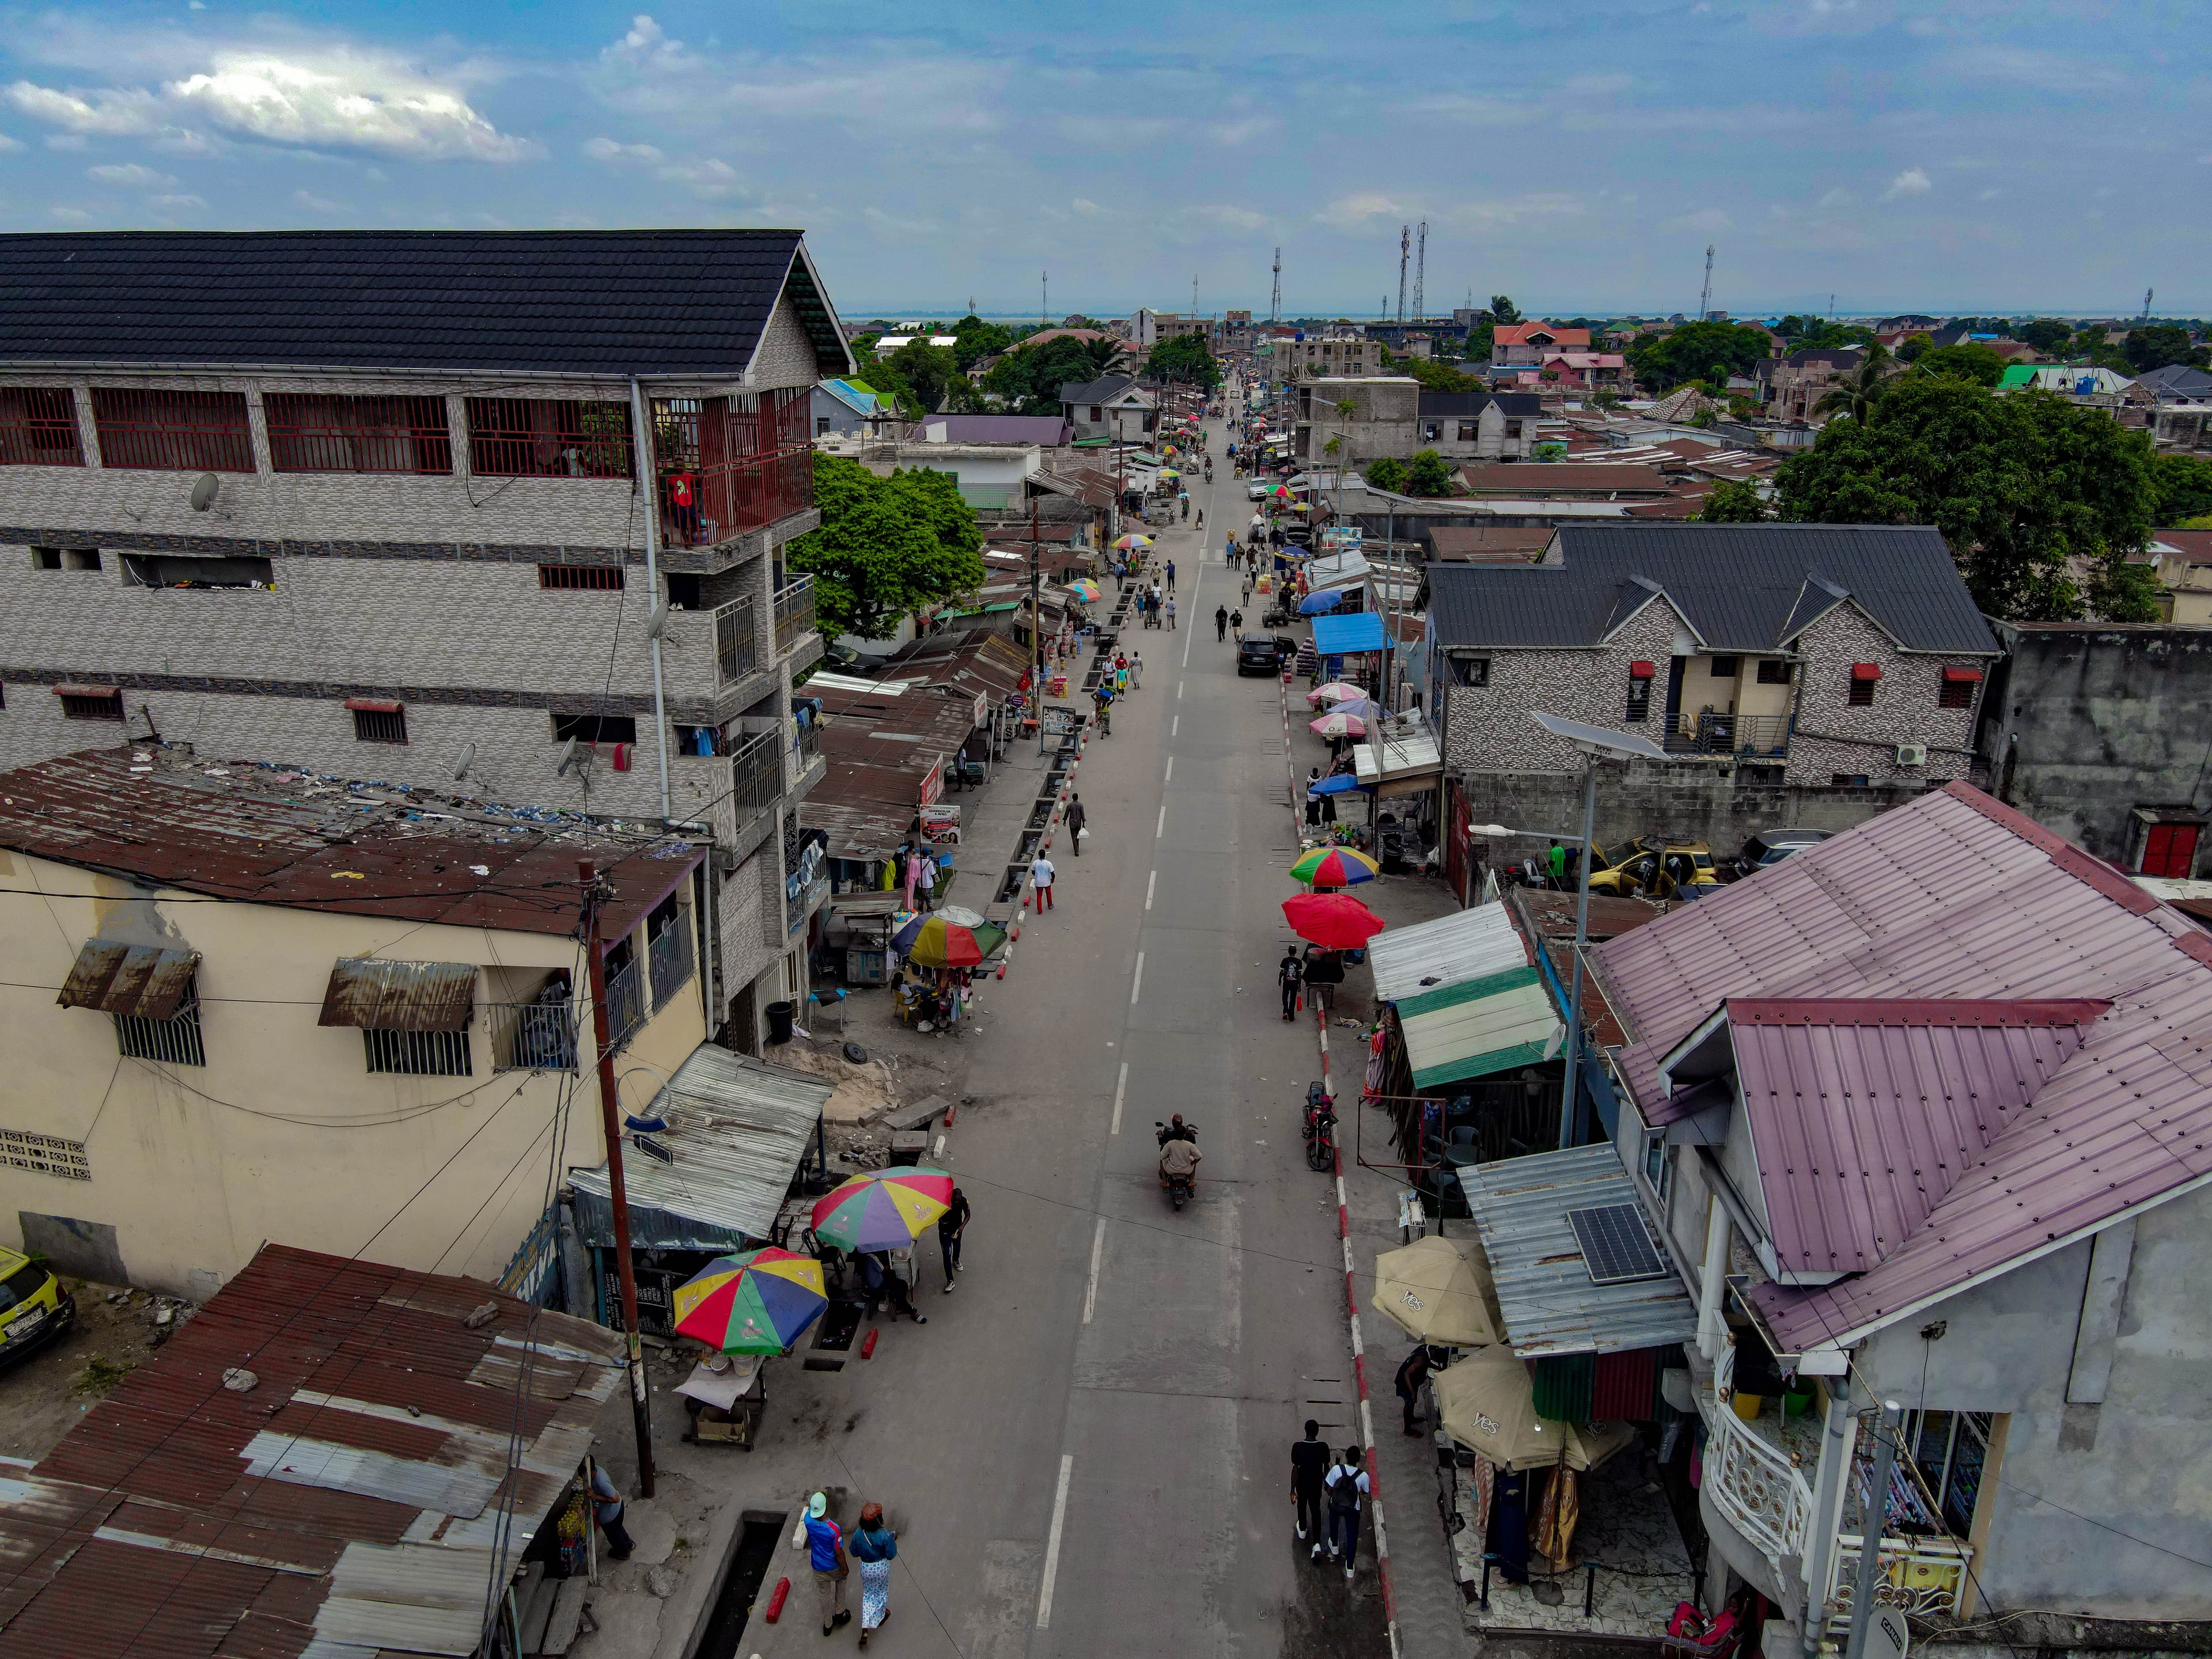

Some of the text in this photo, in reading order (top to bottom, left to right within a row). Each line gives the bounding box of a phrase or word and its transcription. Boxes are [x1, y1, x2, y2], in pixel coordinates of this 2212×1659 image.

[1400, 1289, 1425, 1312] yes
[1471, 1411, 1500, 1434] yes
[1882, 1619, 1901, 1649] CANAL+
